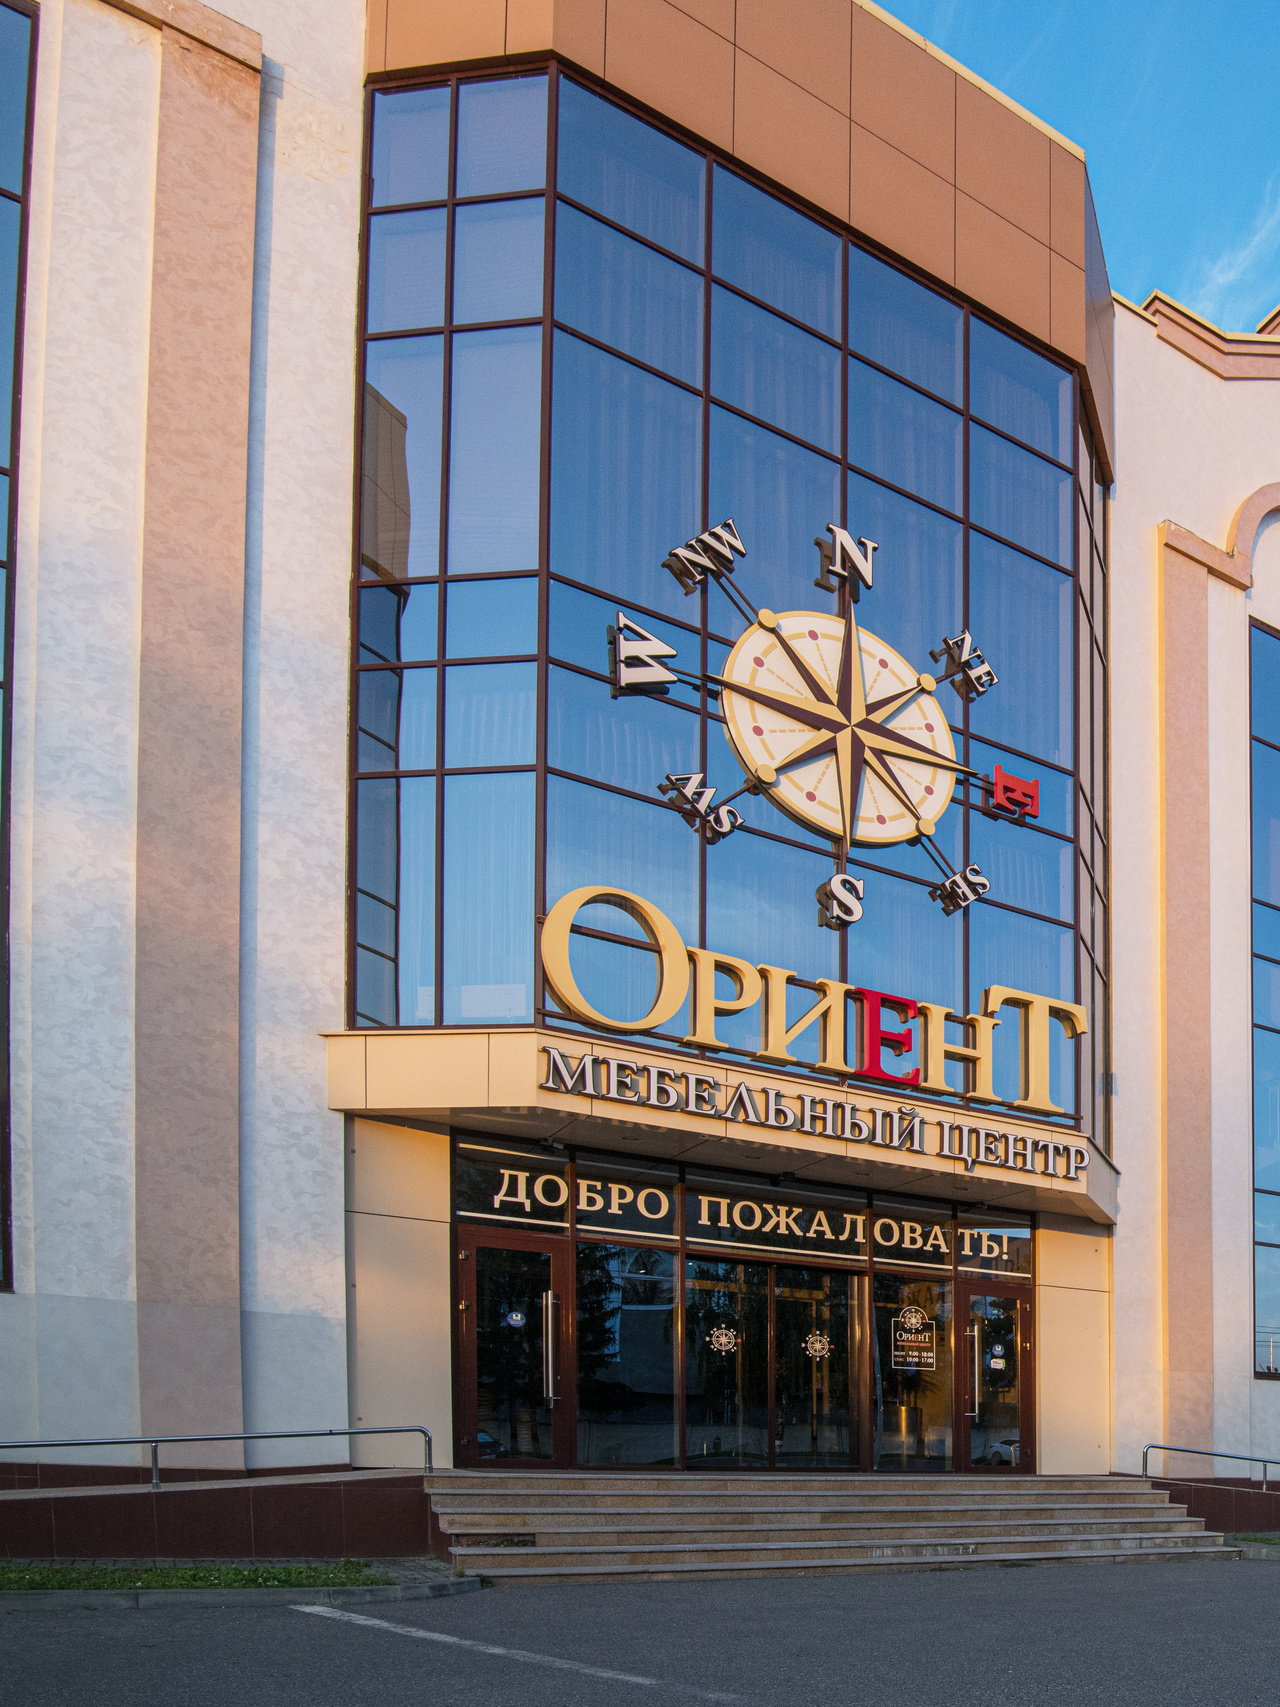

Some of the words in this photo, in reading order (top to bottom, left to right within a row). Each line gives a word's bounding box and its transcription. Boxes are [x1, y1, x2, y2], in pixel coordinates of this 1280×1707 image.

[668, 518, 747, 583] NW
[825, 523, 879, 589] N
[616, 611, 678, 688] W
[943, 629, 999, 697] NE
[993, 764, 1040, 818] E
[827, 873, 864, 925] S
[541, 886, 1088, 1114] ОРИЕНТ
[539, 1046, 927, 1154] МЕБЕЛЬНЫЙ
[937, 1120, 1090, 1180] ЦЕНТР
[493, 1168, 669, 1219] ДОБРО
[698, 1195, 1009, 1260] ПОЖАЛОВАТЬ!
